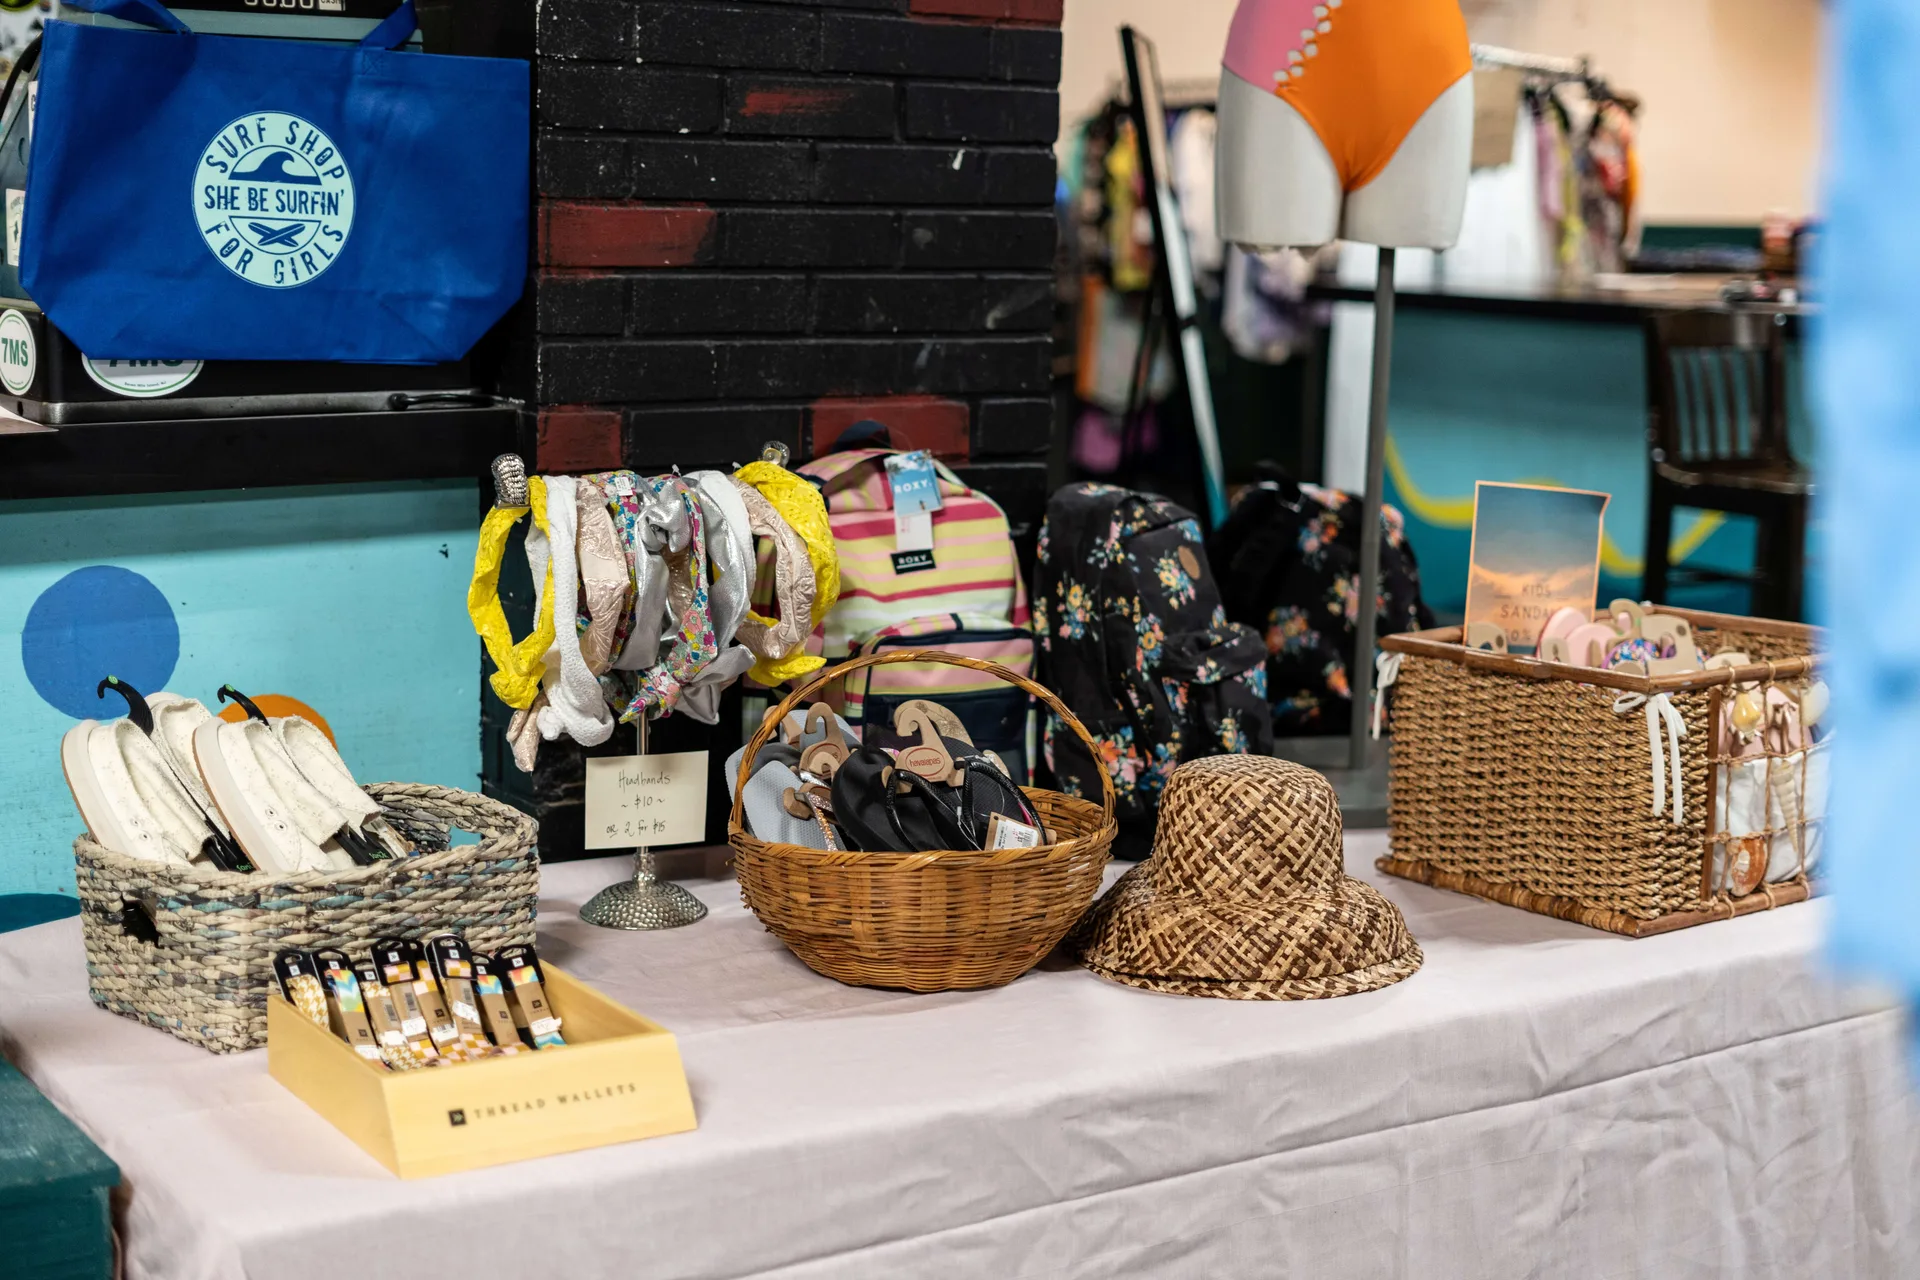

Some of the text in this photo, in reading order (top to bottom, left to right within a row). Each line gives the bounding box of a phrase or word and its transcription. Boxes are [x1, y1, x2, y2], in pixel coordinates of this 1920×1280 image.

[205, 117, 346, 180] SURF SHOP
[204, 184, 345, 217] SHE BE SURFIN'
[204, 220, 344, 285] FOR GIRLS
[1, 337, 29, 367] 7MS
[894, 479, 928, 494] ROXY
[898, 554, 927, 564] ROXY
[1521, 584, 1551, 598] KIDS
[1500, 604, 1550, 620] SANDA
[618, 769, 671, 793] Headbands
[634, 794, 653, 809] $10
[624, 821, 635, 837] 2
[637, 819, 649, 836] for
[473, 1082, 637, 1119] THREAD WALLETS
